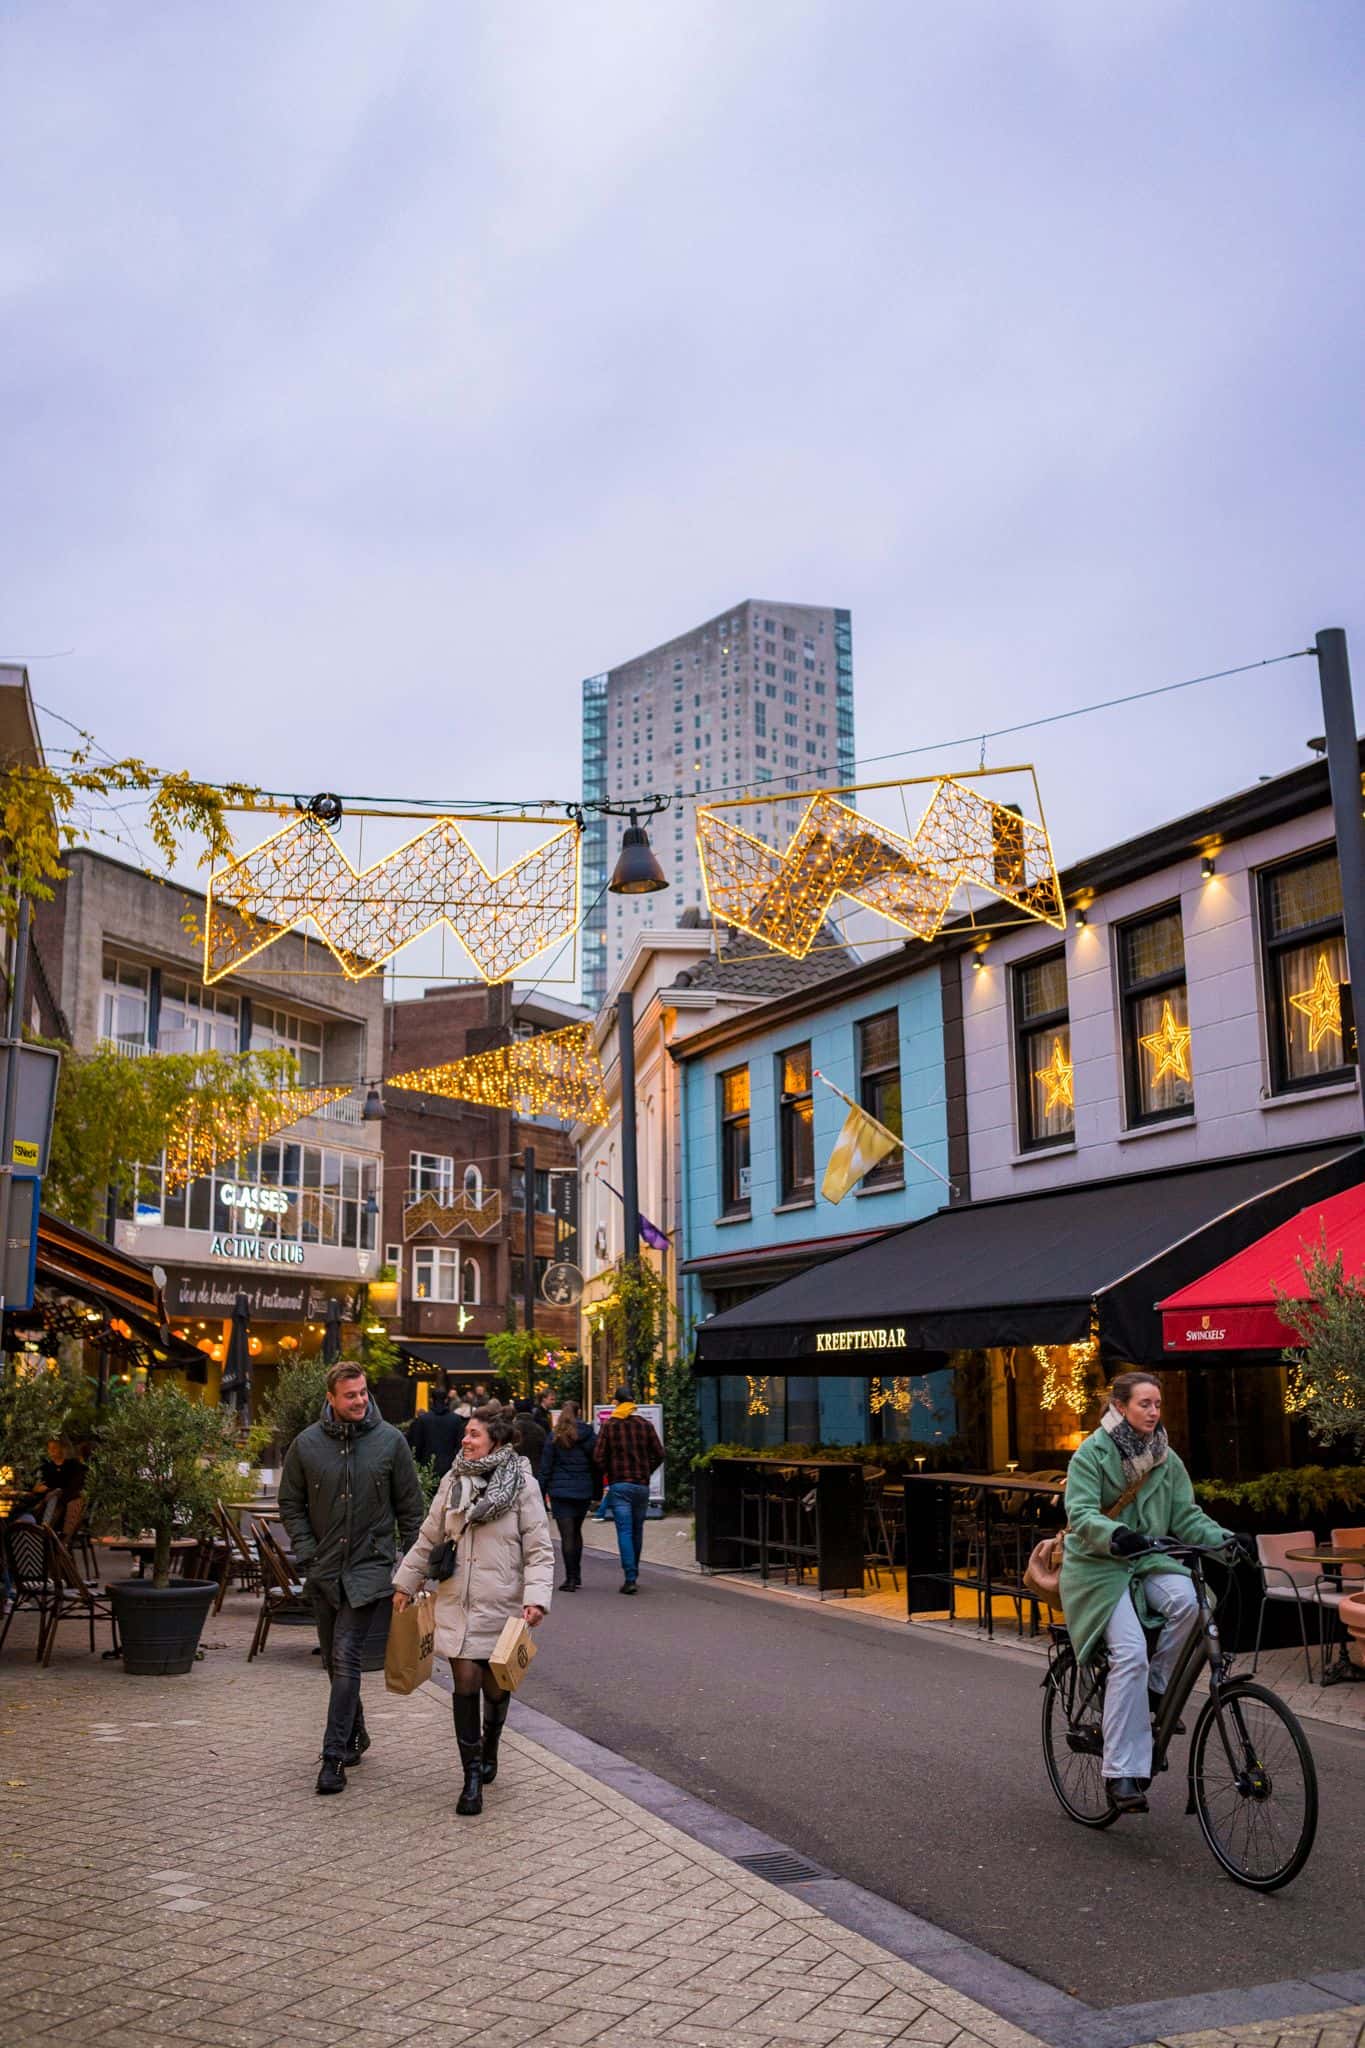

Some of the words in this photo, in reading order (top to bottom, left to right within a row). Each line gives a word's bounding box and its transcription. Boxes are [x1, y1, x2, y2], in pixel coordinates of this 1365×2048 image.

[220, 1183, 289, 1214] CLASSES
[210, 1236, 265, 1260] ACTIVE
[268, 1242, 304, 1264] CLUB
[197, 1280, 209, 1304] de
[816, 1328, 907, 1352] KREEFTENBAR
